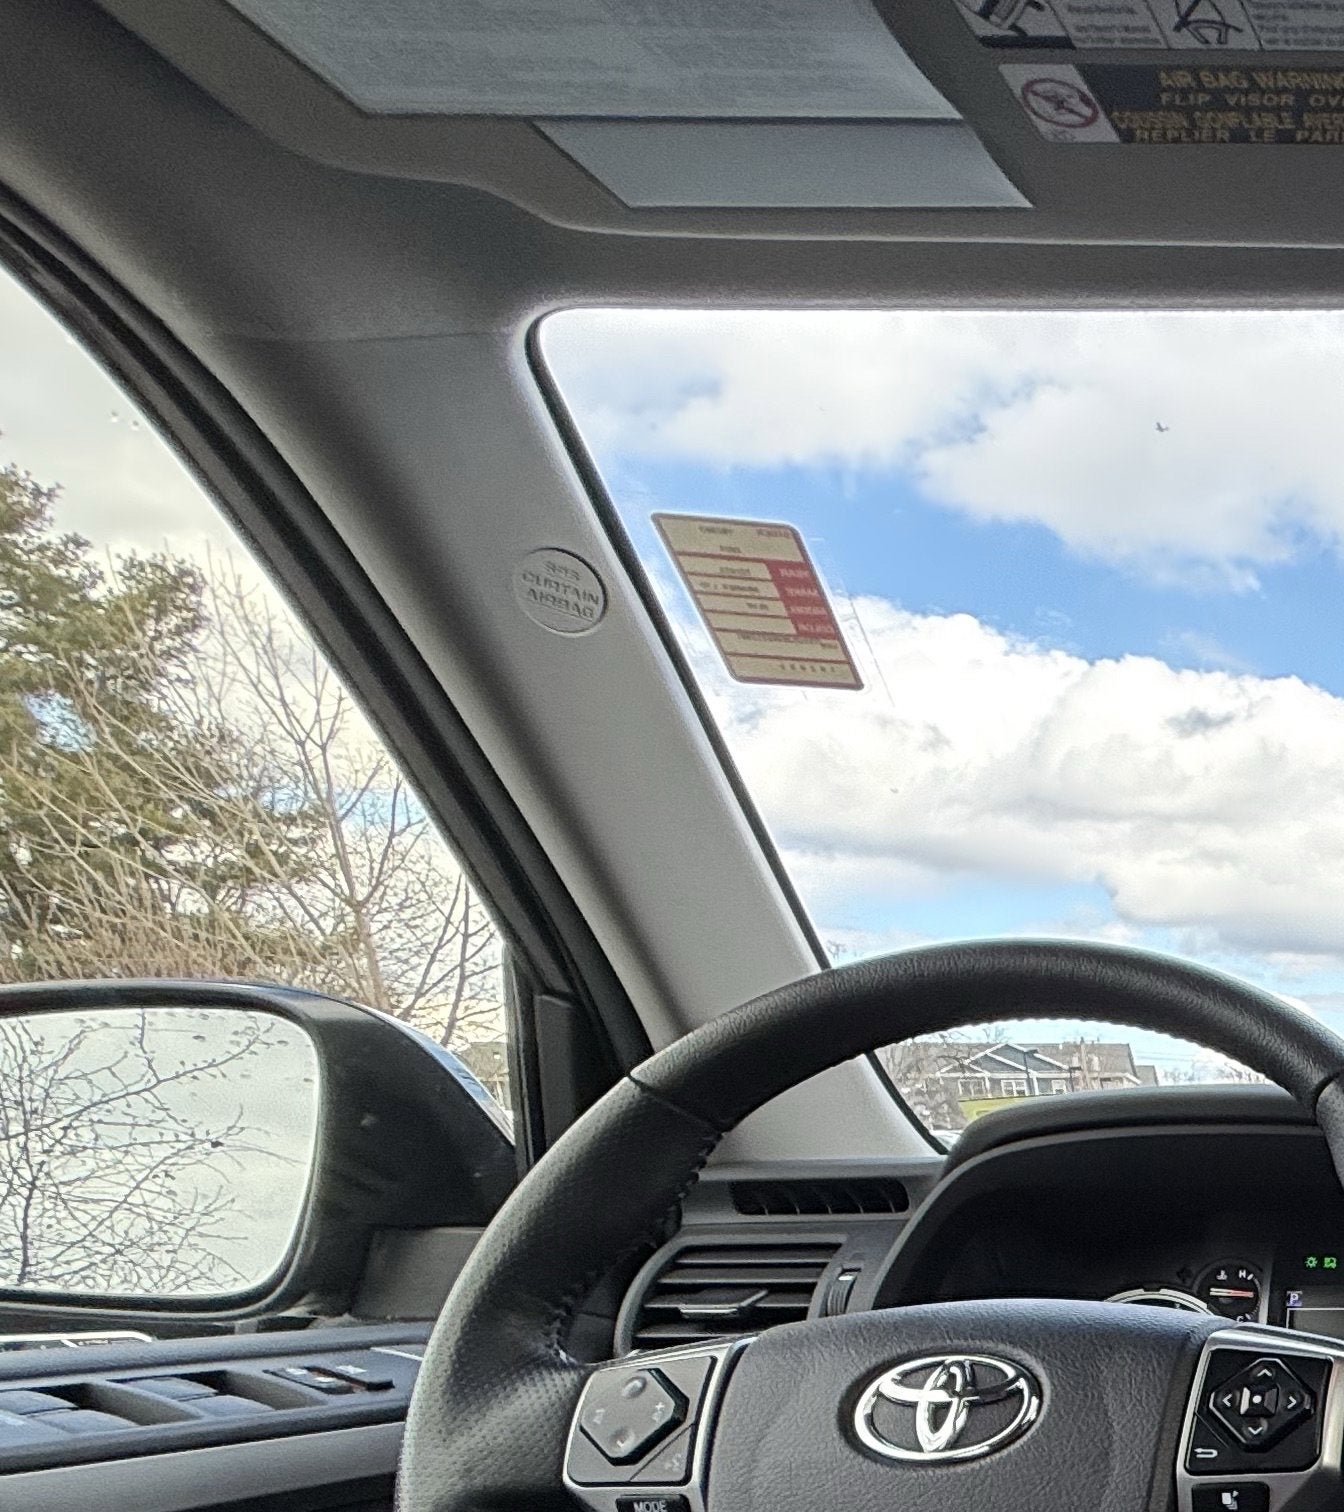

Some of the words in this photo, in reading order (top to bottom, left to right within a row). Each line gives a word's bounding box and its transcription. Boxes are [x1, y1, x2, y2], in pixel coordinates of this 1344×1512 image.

[1159, 71, 1195, 89] AIR
[1199, 71, 1248, 89] BAG
[1159, 92, 1212, 106] FLIP
[1224, 92, 1295, 106] VISOR
[522, 570, 599, 605] CURTAIN
[527, 588, 595, 619] AIRBAG
[633, 1501, 668, 1512] MODE
